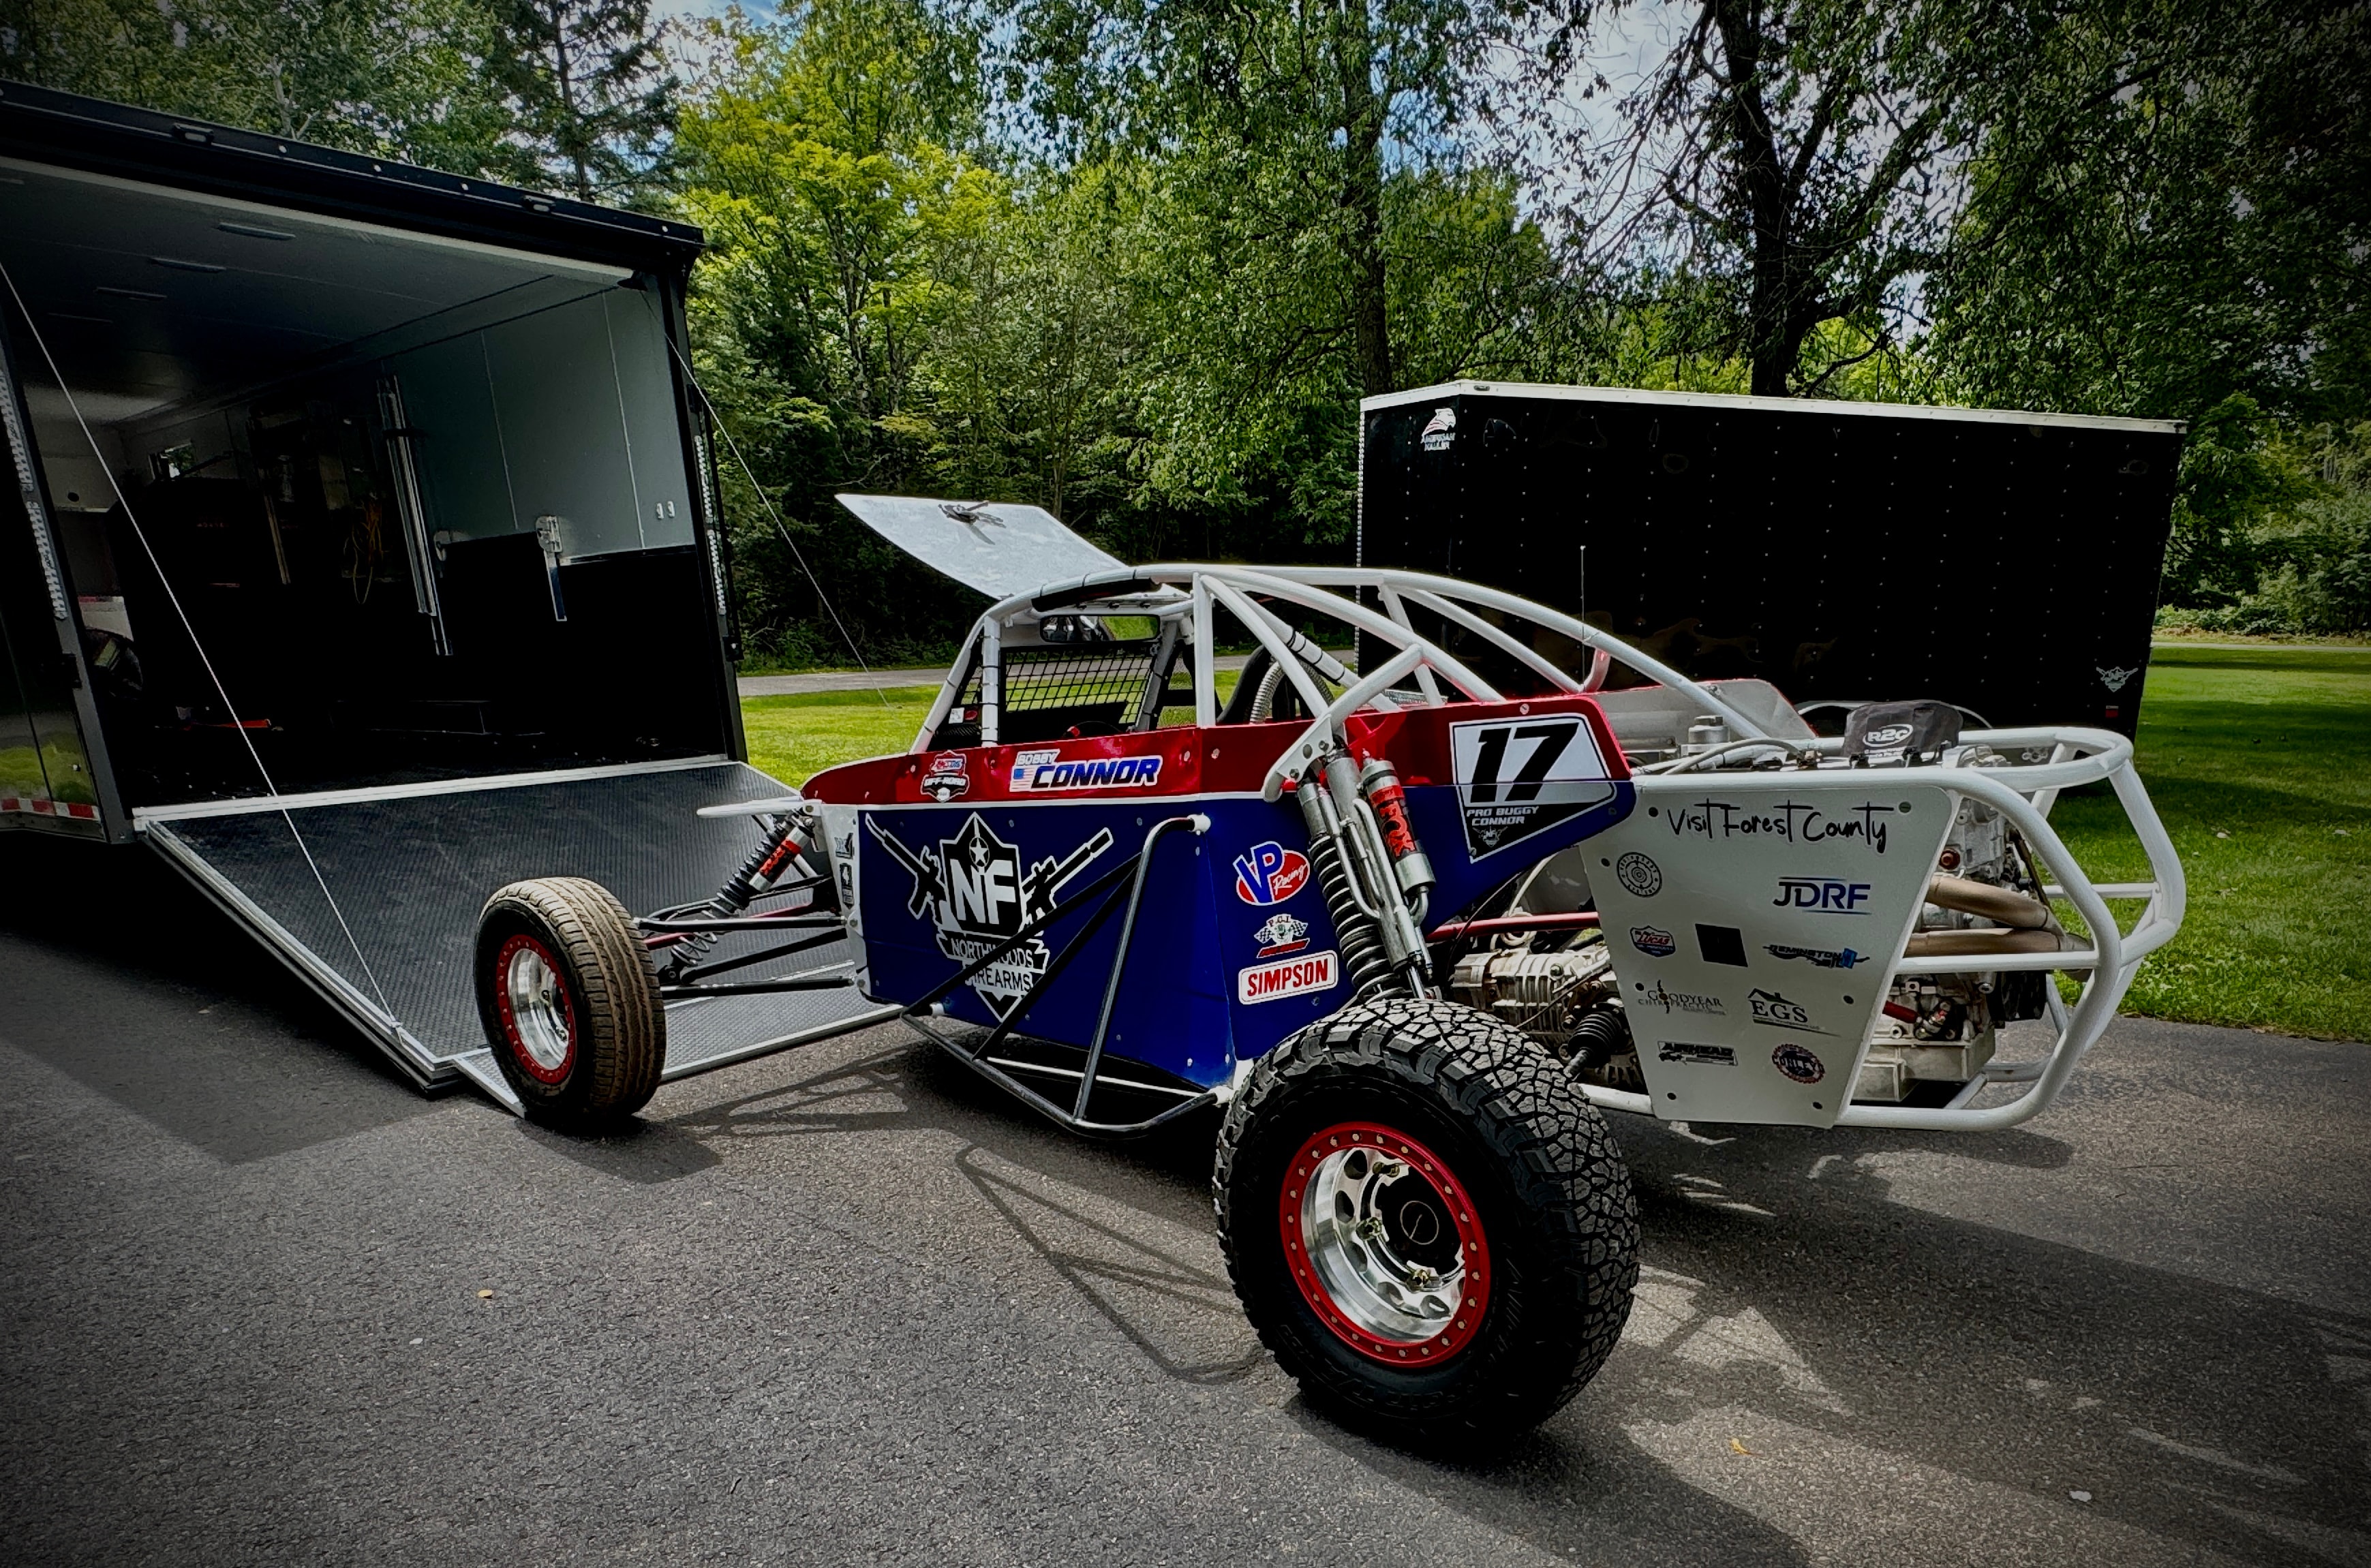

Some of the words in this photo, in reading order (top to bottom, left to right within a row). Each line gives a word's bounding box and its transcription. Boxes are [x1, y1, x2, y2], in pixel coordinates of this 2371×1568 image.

[1016, 752, 1056, 766] BOBBY
[1031, 757, 1161, 789] CONNOR
[1470, 722, 1579, 803] 17
[1467, 808, 1493, 816] PRO
[1496, 806, 1539, 816] BUGGY
[1472, 816, 1525, 826] CONNOR
[1668, 797, 1732, 840] Visit
[1722, 799, 1814, 842] Forest
[1803, 801, 1894, 854] County
[1233, 841, 1285, 906] VP
[1272, 863, 1308, 896] Racing
[949, 858, 1017, 925] NF
[1773, 881, 1871, 909] JDRF
[1637, 934, 1670, 945] LUCAS
[1247, 958, 1329, 997] SIMPSON
[1749, 1000, 1808, 1023] EGS
